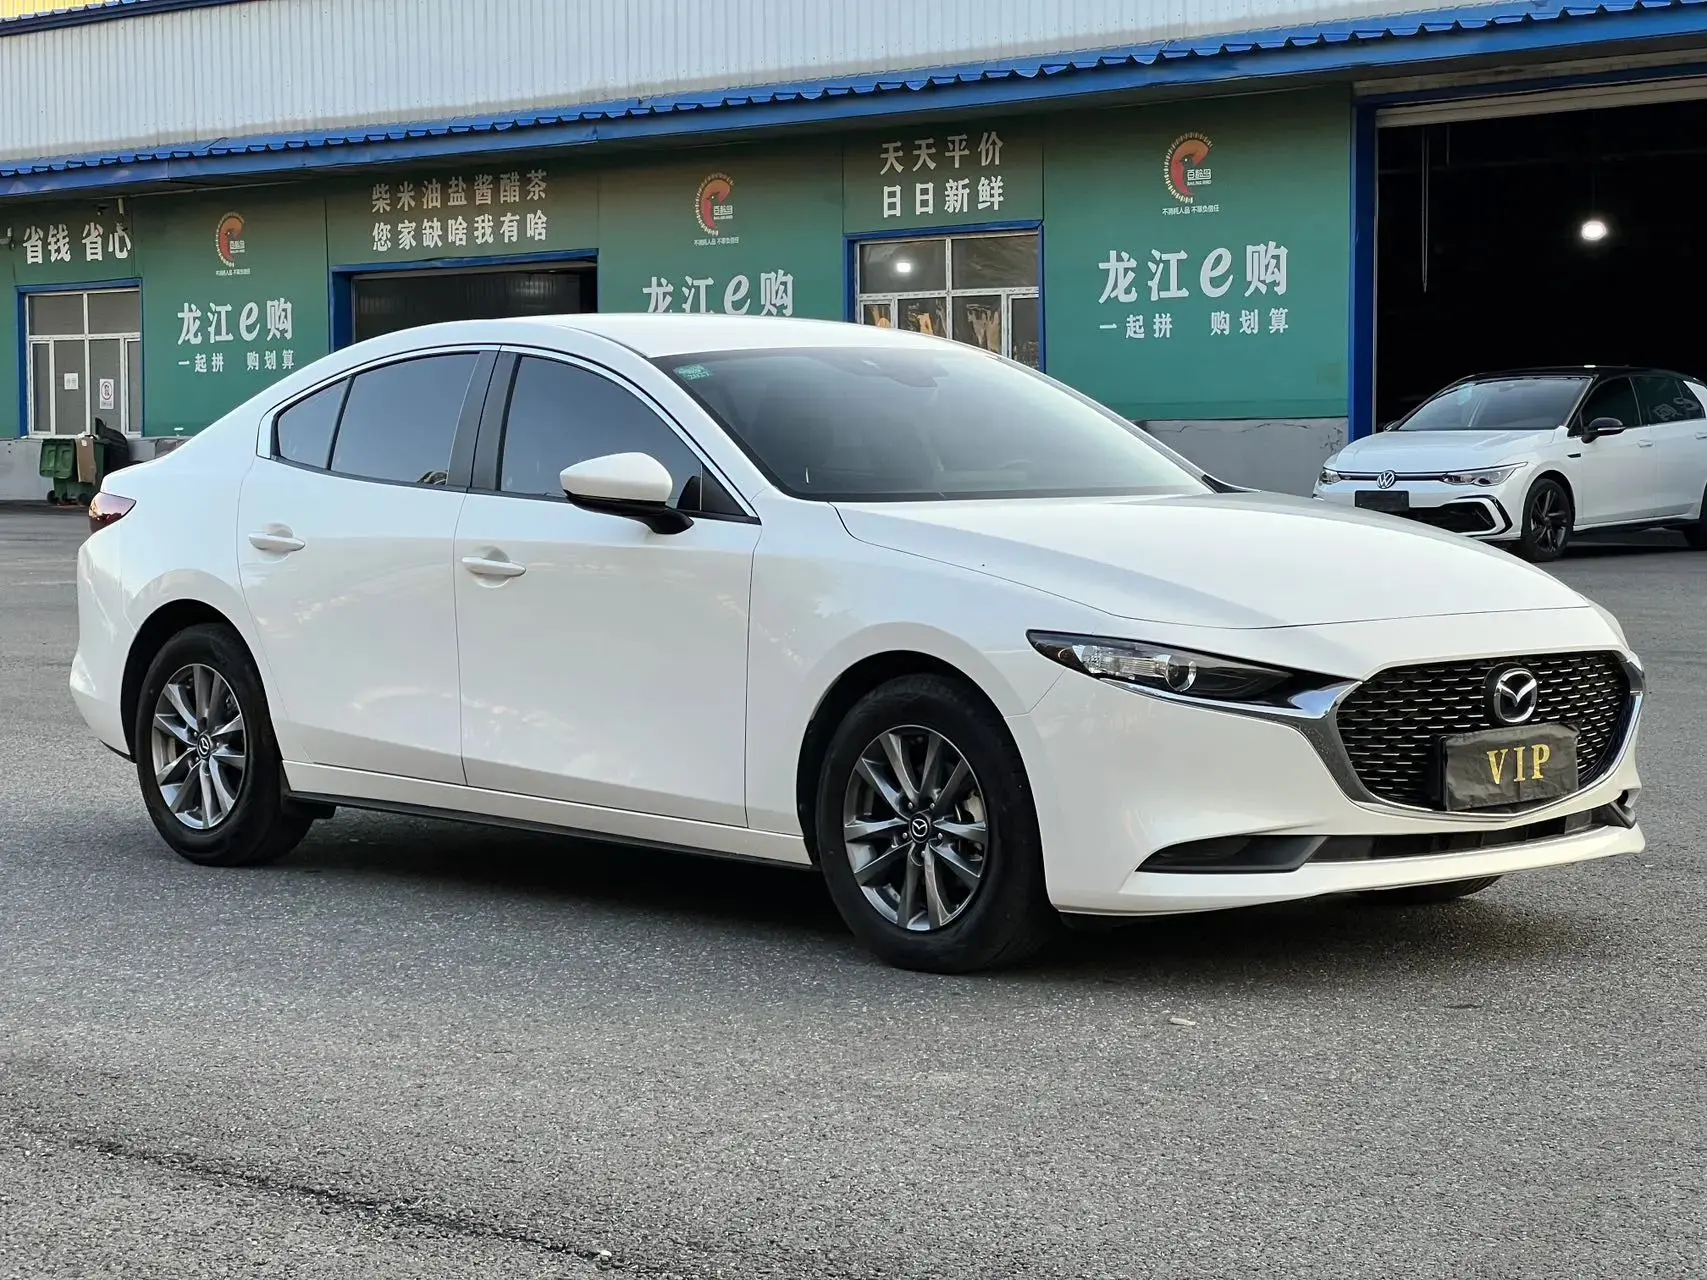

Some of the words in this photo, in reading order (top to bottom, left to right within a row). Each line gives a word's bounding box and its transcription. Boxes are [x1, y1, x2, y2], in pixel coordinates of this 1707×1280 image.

[880, 132, 1003, 175] 天天平价
[372, 169, 547, 213] 柴米油盐酱醋茶
[883, 176, 1004, 218] 日日新鲜
[22, 223, 71, 264] 省钱
[82, 222, 131, 261] 省心
[372, 210, 547, 251] 您家缺啥我有啥
[1098, 240, 1289, 304] 龙江e购
[177, 297, 293, 345] 龙江e购
[1099, 313, 1173, 339] 一起拼
[1210, 307, 1289, 336] 购划算
[178, 353, 224, 373] 一起拼
[247, 349, 294, 371] 购划算
[1486, 743, 1550, 785] VIP
